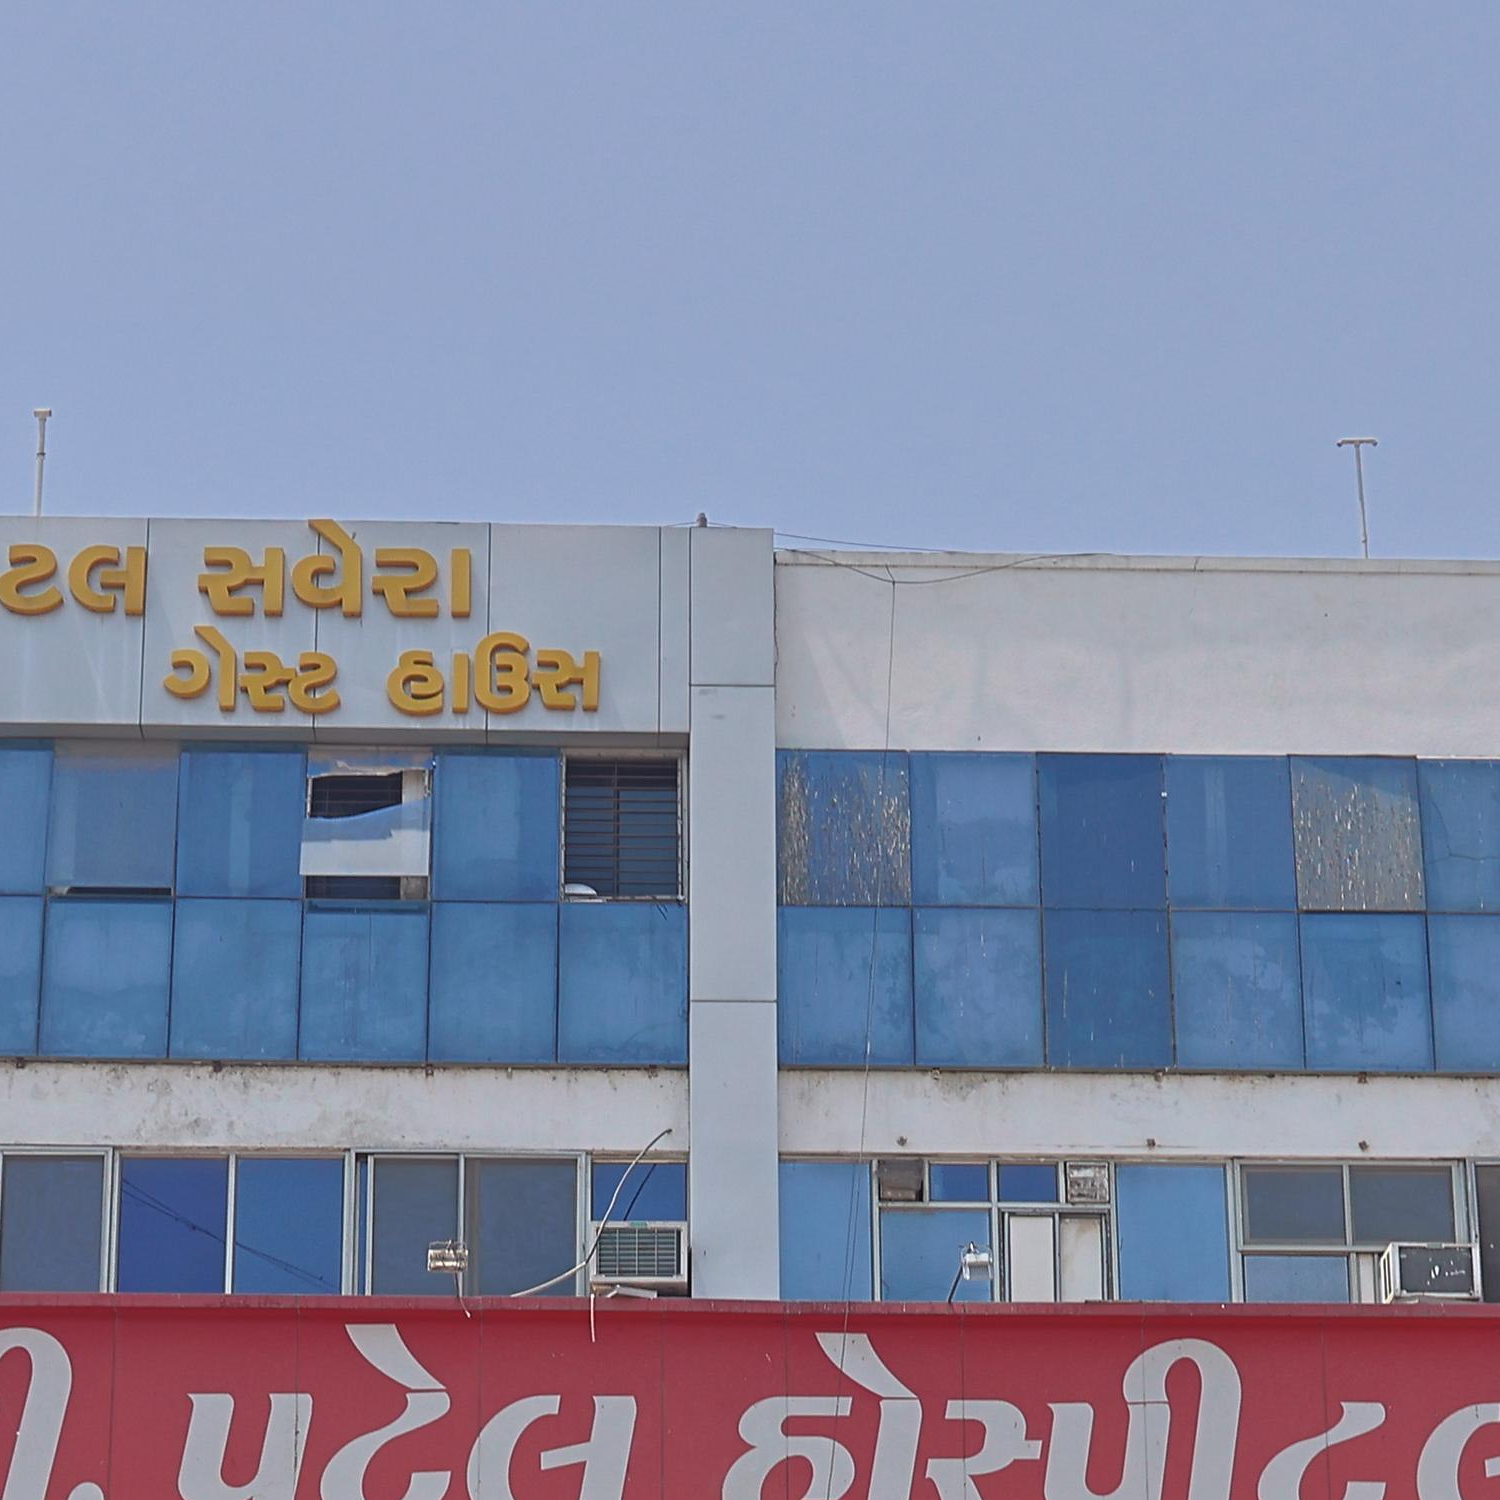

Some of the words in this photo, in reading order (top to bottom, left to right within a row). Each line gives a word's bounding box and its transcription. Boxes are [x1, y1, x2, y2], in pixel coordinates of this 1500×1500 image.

[198, 519, 472, 618] સવેરા
[164, 626, 341, 714] ગેસ્ટ
[387, 632, 601, 714] હાઉસ
